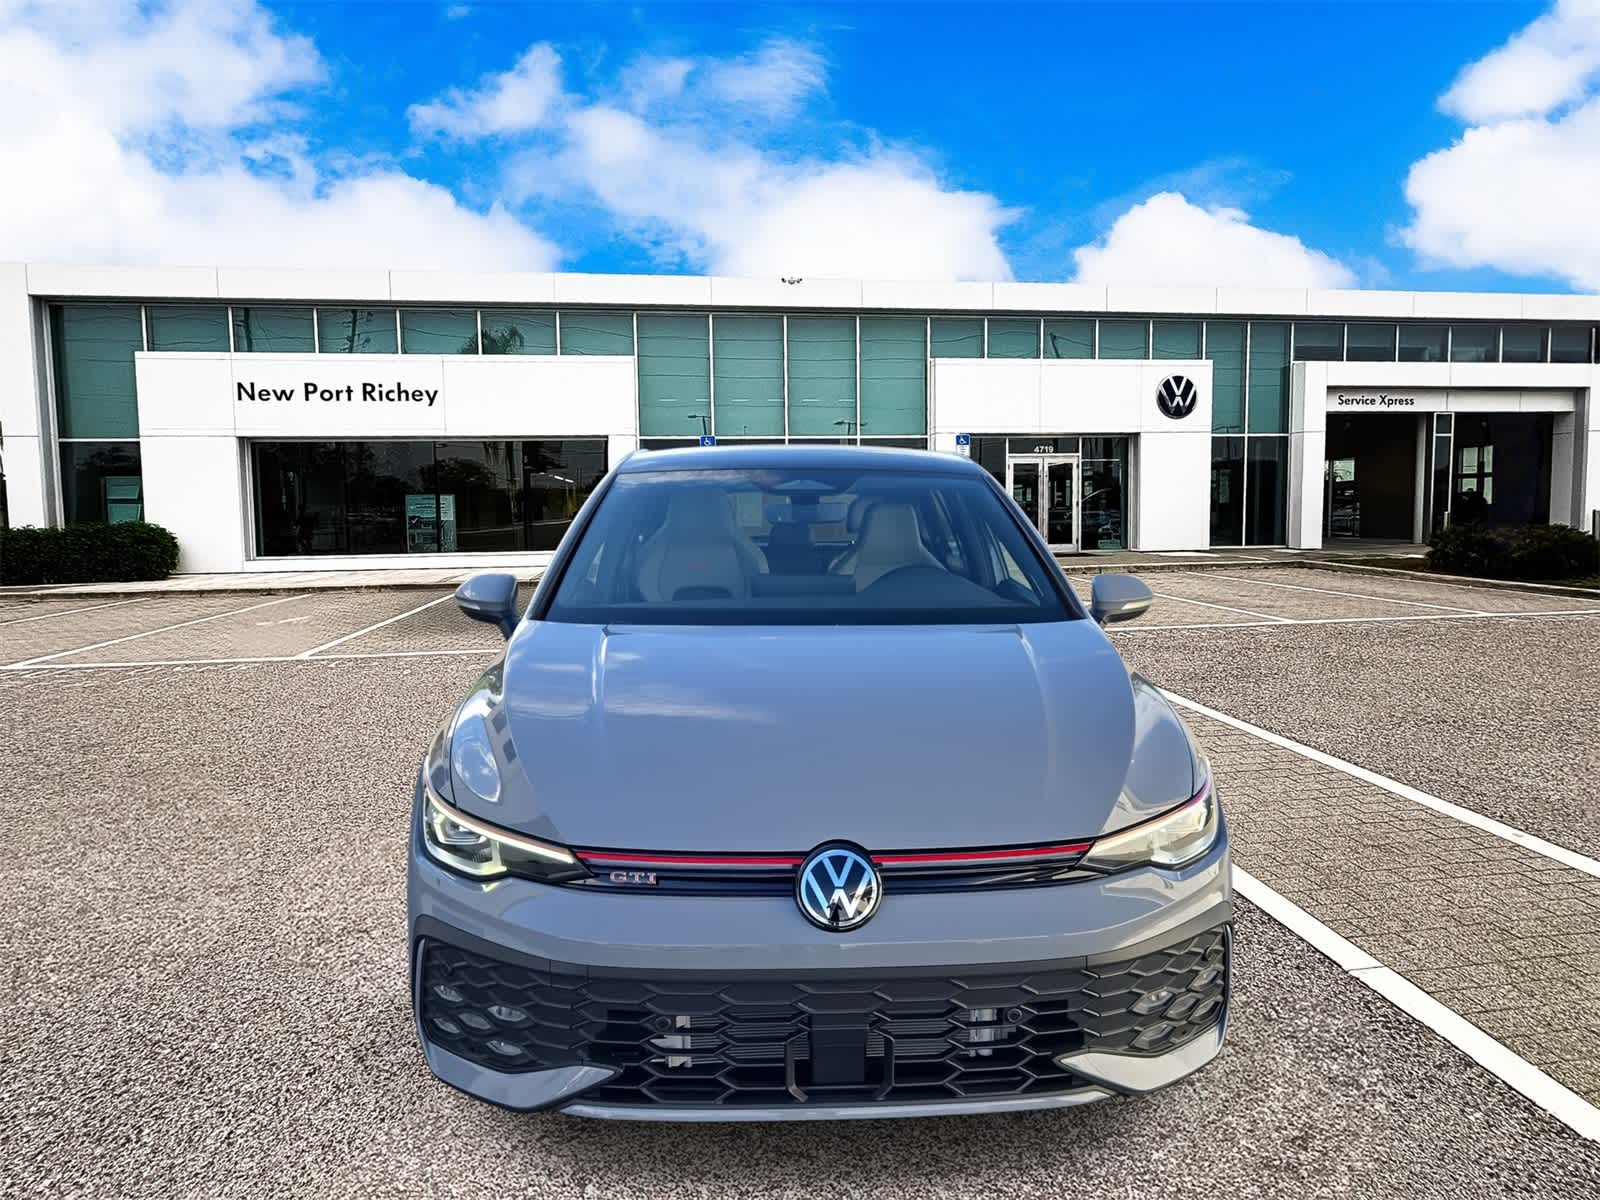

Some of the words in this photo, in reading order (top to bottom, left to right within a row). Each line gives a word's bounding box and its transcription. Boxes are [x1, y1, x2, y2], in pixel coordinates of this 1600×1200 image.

[237, 381, 295, 402] New
[303, 382, 354, 402] Port
[361, 381, 439, 407] Richey
[1337, 394, 1376, 406] Service
[1379, 394, 1415, 408] Xpress
[1033, 445, 1054, 453] 4719
[609, 871, 657, 885] GTI
